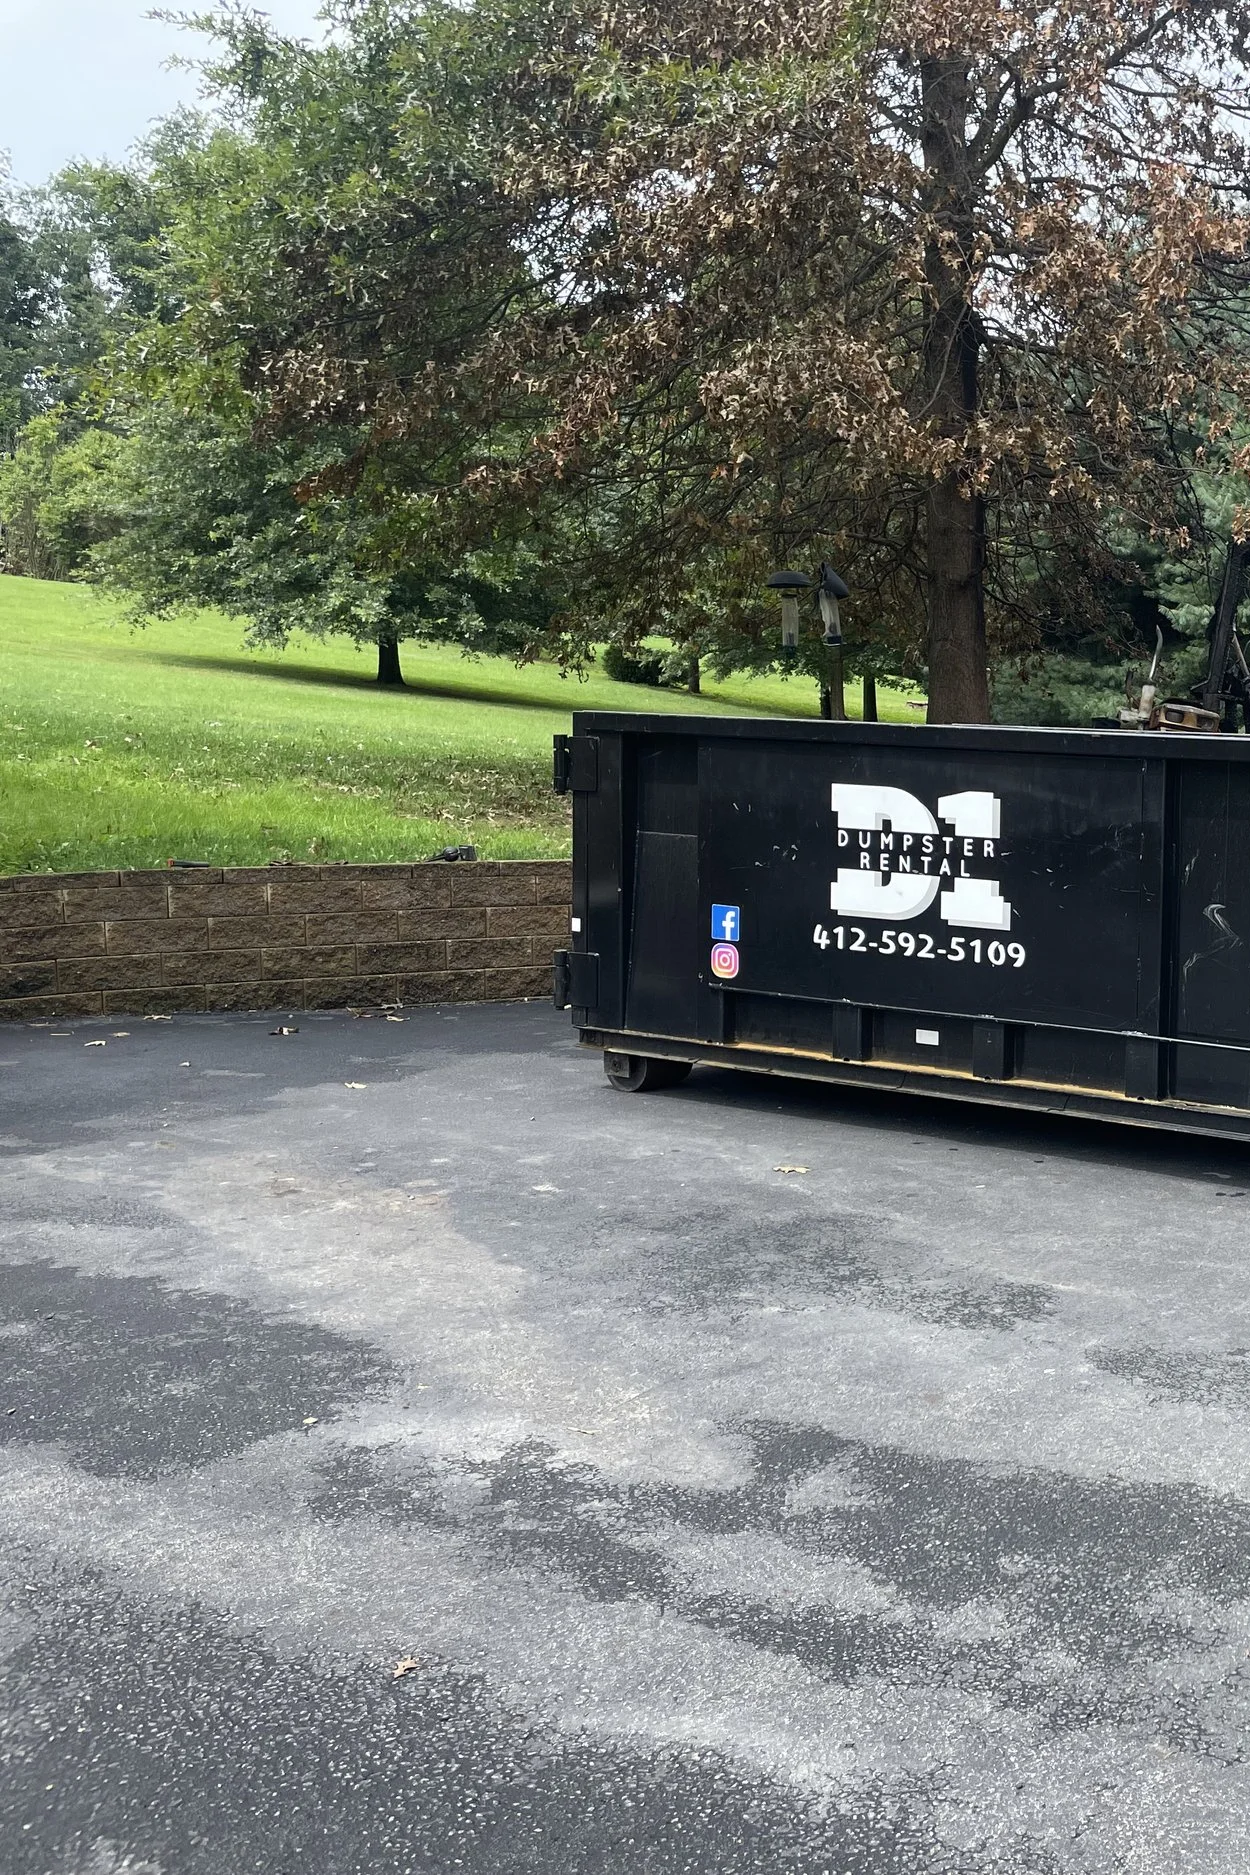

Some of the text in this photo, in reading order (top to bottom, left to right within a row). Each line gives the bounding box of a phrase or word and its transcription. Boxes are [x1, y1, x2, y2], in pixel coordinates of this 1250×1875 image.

[830, 782, 1011, 931] D1
[837, 829, 996, 858] DUMPSTER
[860, 853, 971, 878] RENTAL
[812, 923, 1026, 968] 412-592-5109
